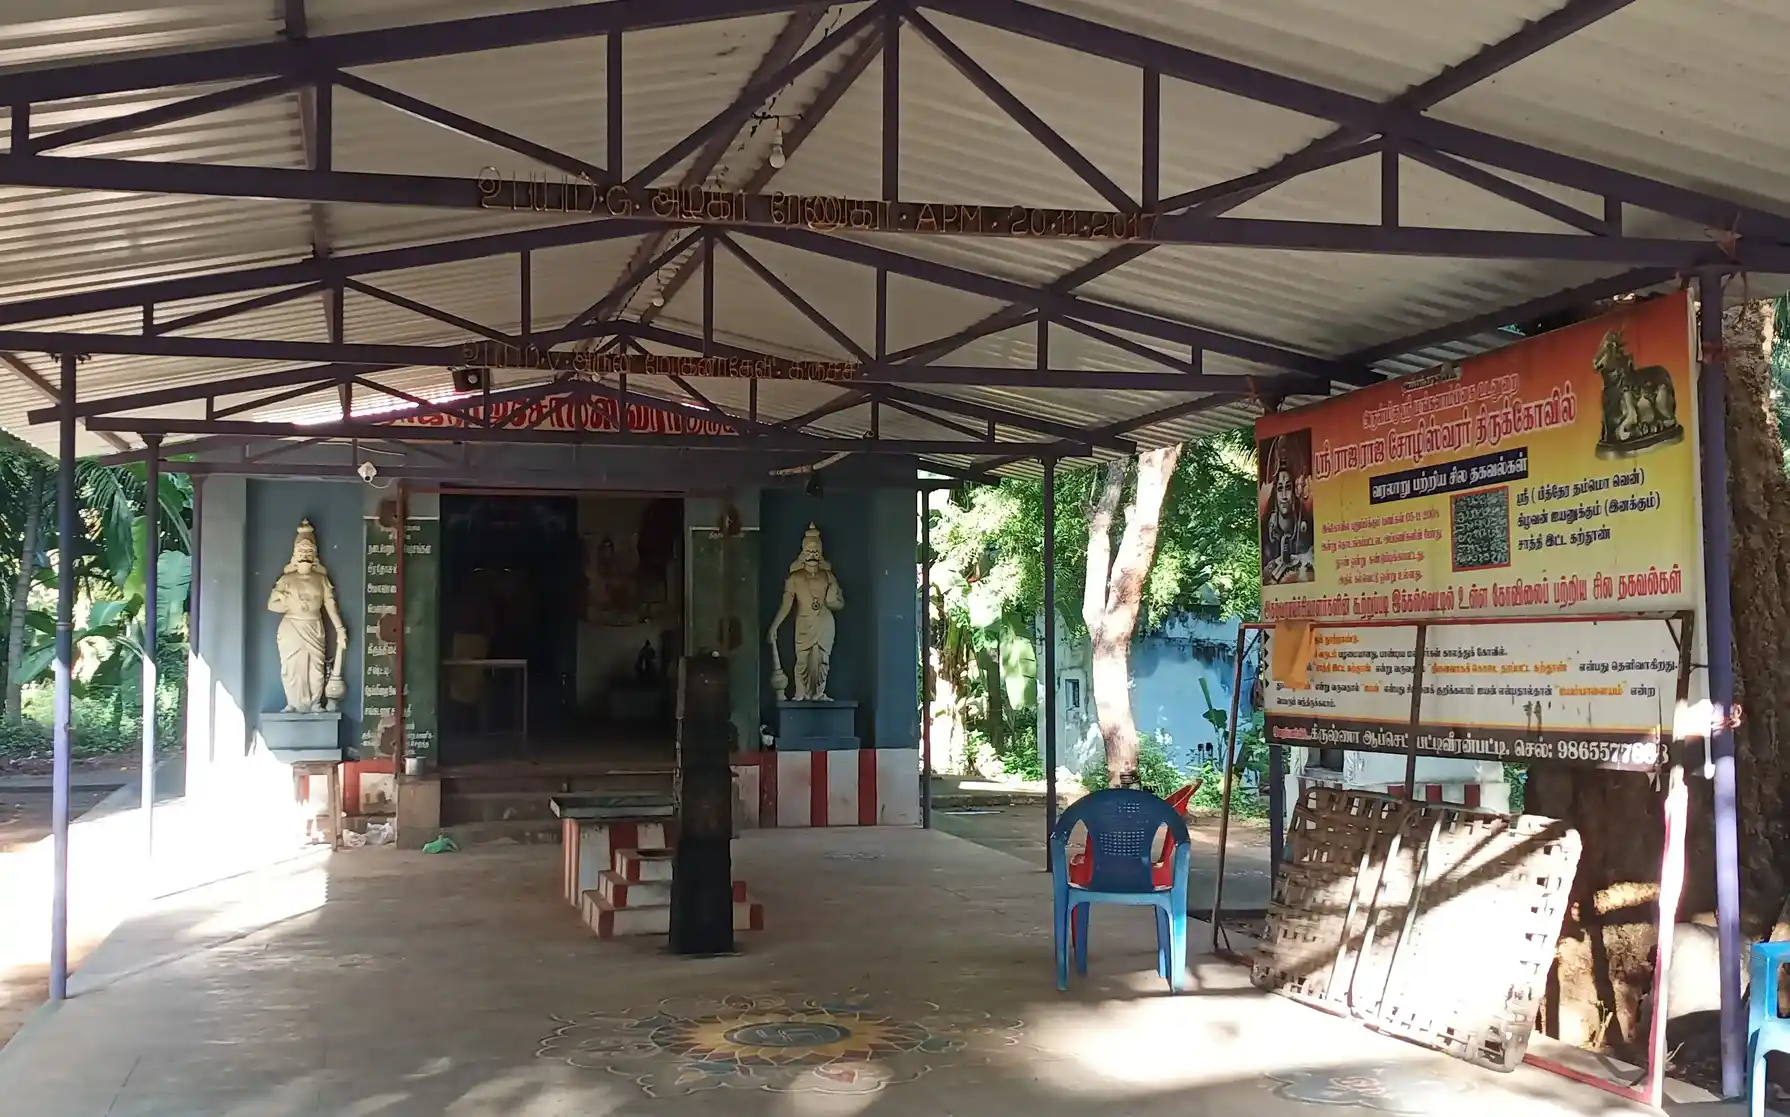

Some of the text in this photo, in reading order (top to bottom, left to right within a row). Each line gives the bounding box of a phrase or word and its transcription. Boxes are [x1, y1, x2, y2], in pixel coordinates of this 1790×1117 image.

[1315, 439, 1331, 479] ஸ்ரீ
[1333, 446, 1357, 474] ராஜ
[1359, 439, 1384, 469] ராஜ
[1475, 380, 1576, 445] திருக்கோவில்
[1372, 451, 1527, 503] வரலாறு பற்றிய சில தகவல்கள்
[1516, 487, 1530, 507] ஸ்ரீ
[1553, 571, 1587, 609] பற்றிய
[1592, 569, 1614, 601] சில
[1617, 562, 1681, 602] தகவல்கள்
